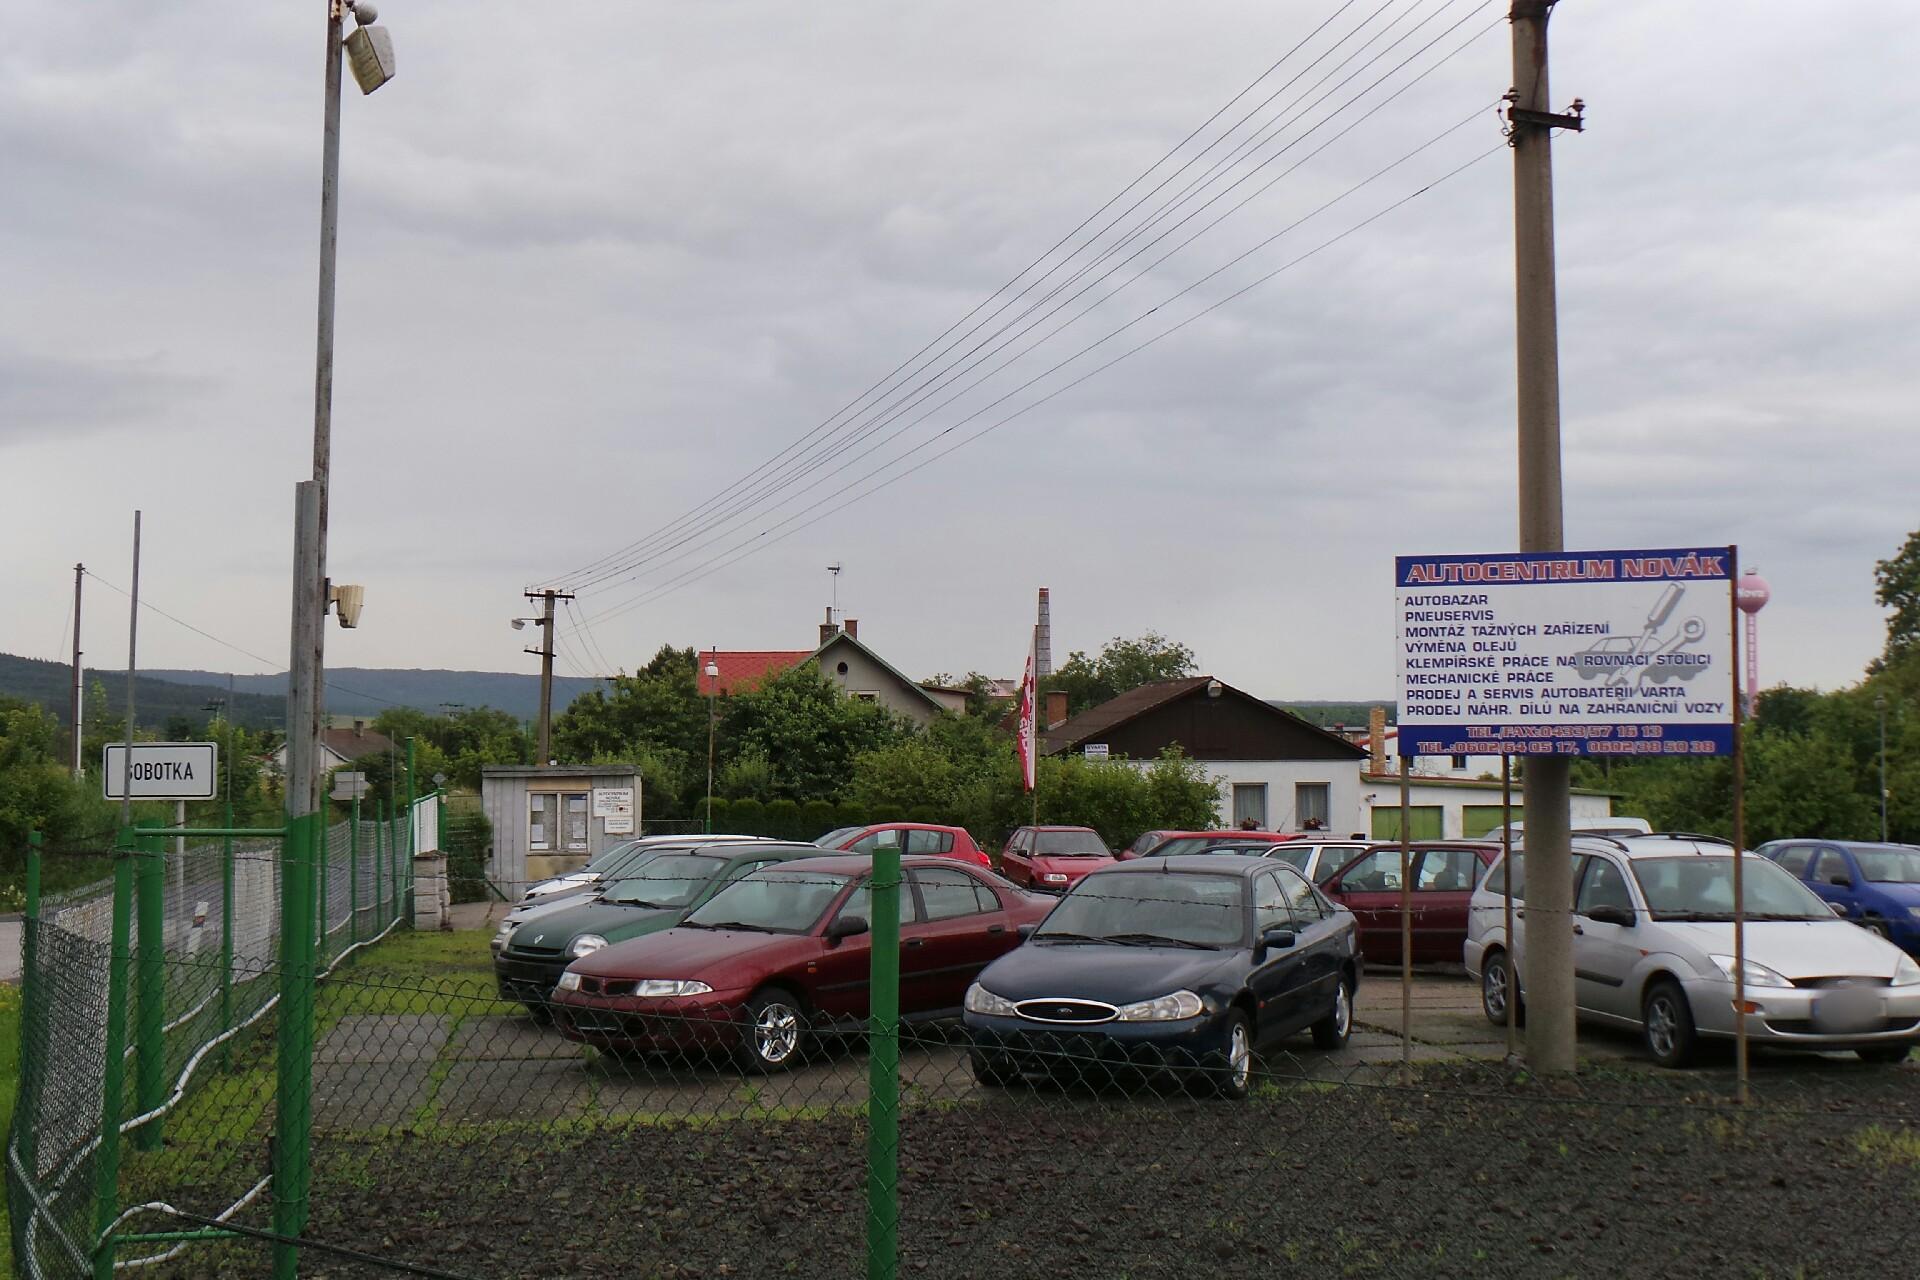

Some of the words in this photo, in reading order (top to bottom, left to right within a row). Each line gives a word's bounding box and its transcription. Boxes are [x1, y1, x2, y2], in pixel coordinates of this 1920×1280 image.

[1405, 559, 1615, 582] AUTOCENTRUM
[1621, 552, 1725, 577] NOVÁK
[1405, 595, 1488, 606] AUTOBAZAR
[1405, 610, 1494, 622] PNEUSERVIS
[1406, 624, 1465, 637] MONTÁŽ
[1471, 622, 1536, 636] TAŽNÝCH
[1544, 621, 1610, 635] ZAŘÍZENÍ
[1406, 640, 1466, 653] VÝMĚNA
[1473, 638, 1517, 652] OLEJŮ
[1406, 655, 1495, 668] KLEMPÍŘSKÉ
[1503, 654, 1549, 667] PRÁCE
[1556, 656, 1577, 666] NA
[1584, 653, 1649, 666] ROVNACÍ
[1657, 654, 1711, 665] STOLICI
[1406, 670, 1500, 684] MECHANICKÉ
[1507, 669, 1553, 683] PRÁCE
[1407, 689, 1460, 700] PRODEJ
[1468, 689, 1477, 699] A
[1484, 688, 1534, 699] SERVIS
[1541, 687, 1633, 699] AUTOBATERII
[1640, 687, 1685, 698] VARTA
[1407, 705, 1460, 716] PRODEJ
[1468, 702, 1511, 715] NÁHR.
[1520, 701, 1551, 714] DÍLŮ
[1560, 704, 1580, 714] NA
[1587, 700, 1677, 714] ZAHRANIČNÍ
[1685, 703, 1724, 713] VOZY
